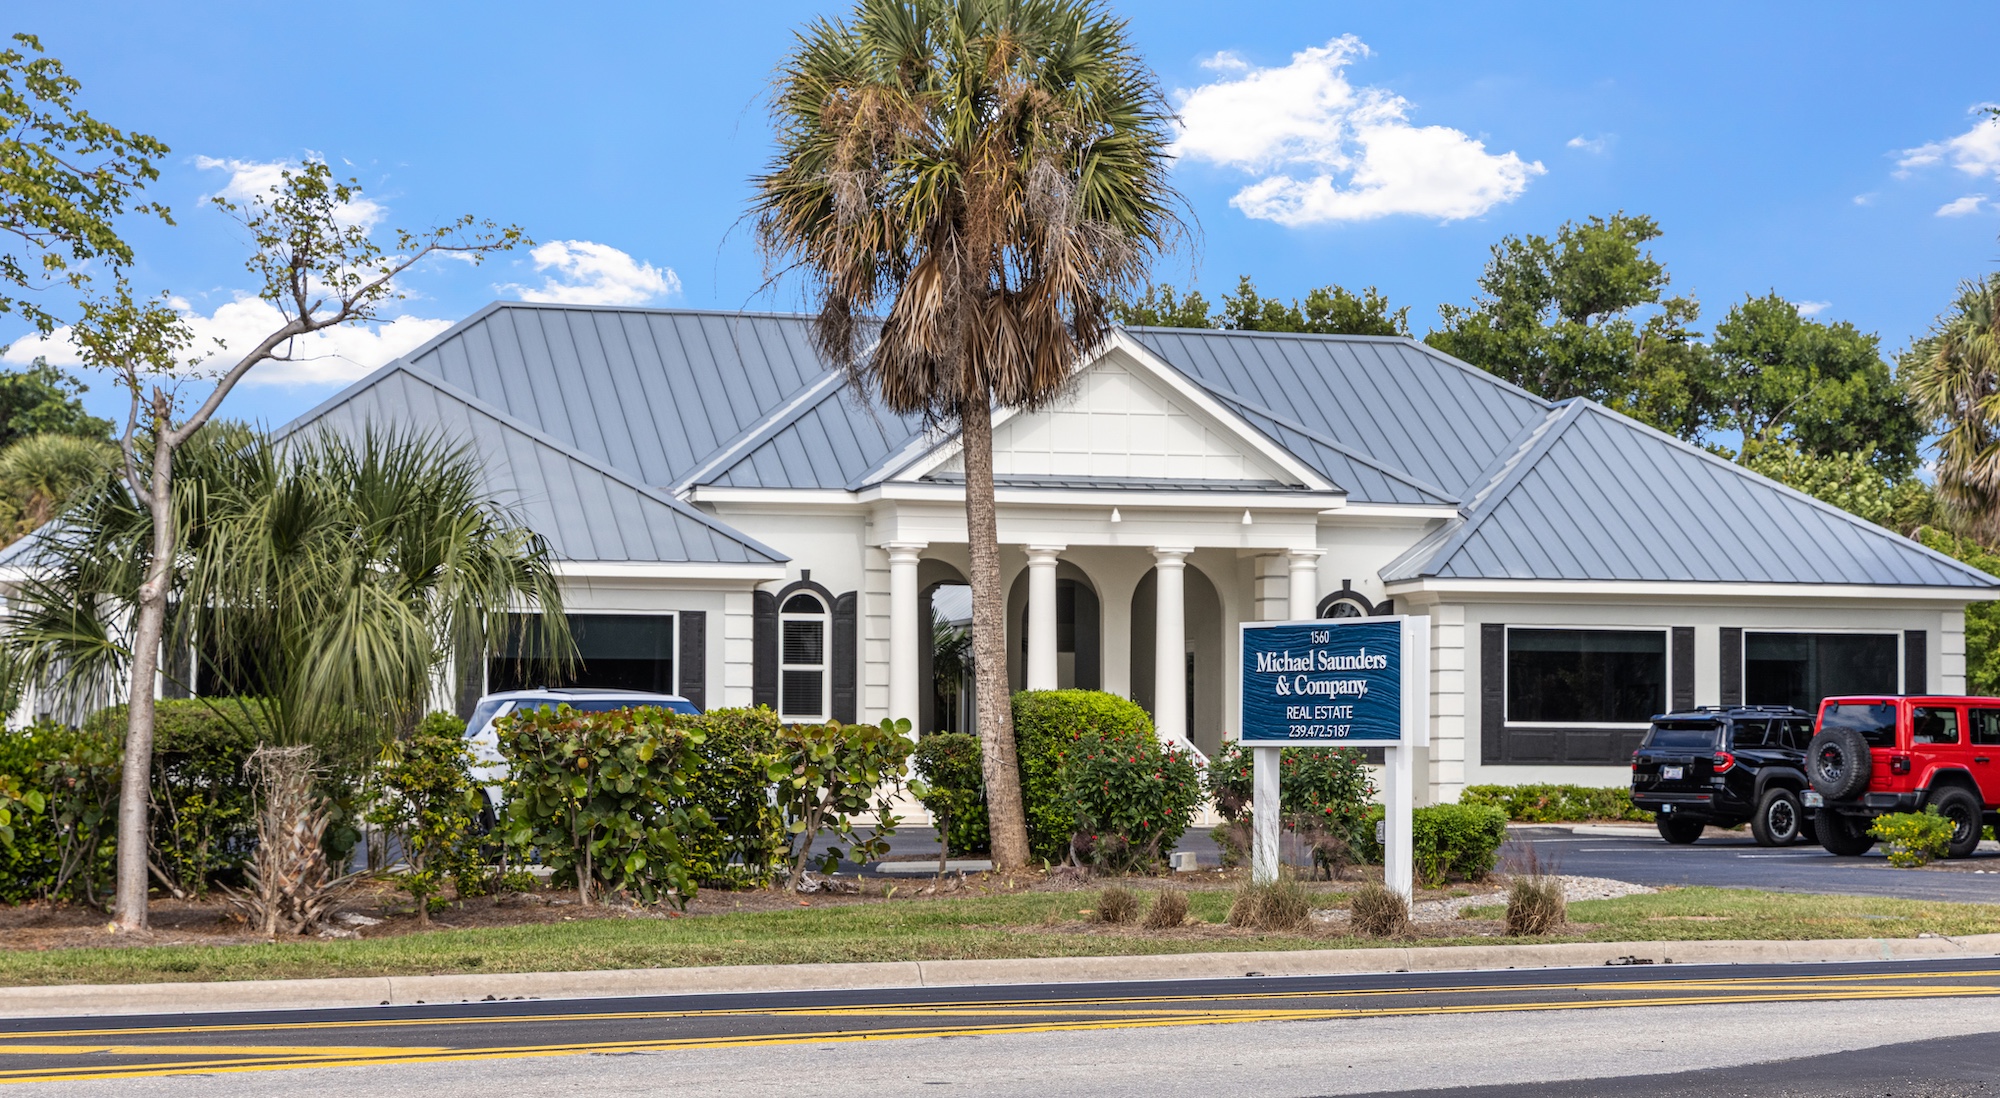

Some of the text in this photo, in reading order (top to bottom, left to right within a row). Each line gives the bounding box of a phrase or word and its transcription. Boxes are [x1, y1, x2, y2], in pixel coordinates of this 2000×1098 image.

[1310, 630, 1330, 644] 1560
[1256, 647, 1387, 673] Michael Saunders
[1275, 675, 1291, 696] &
[1286, 705, 1353, 720] REAL ESTATE
[1288, 724, 1351, 738] 239.472.5187
